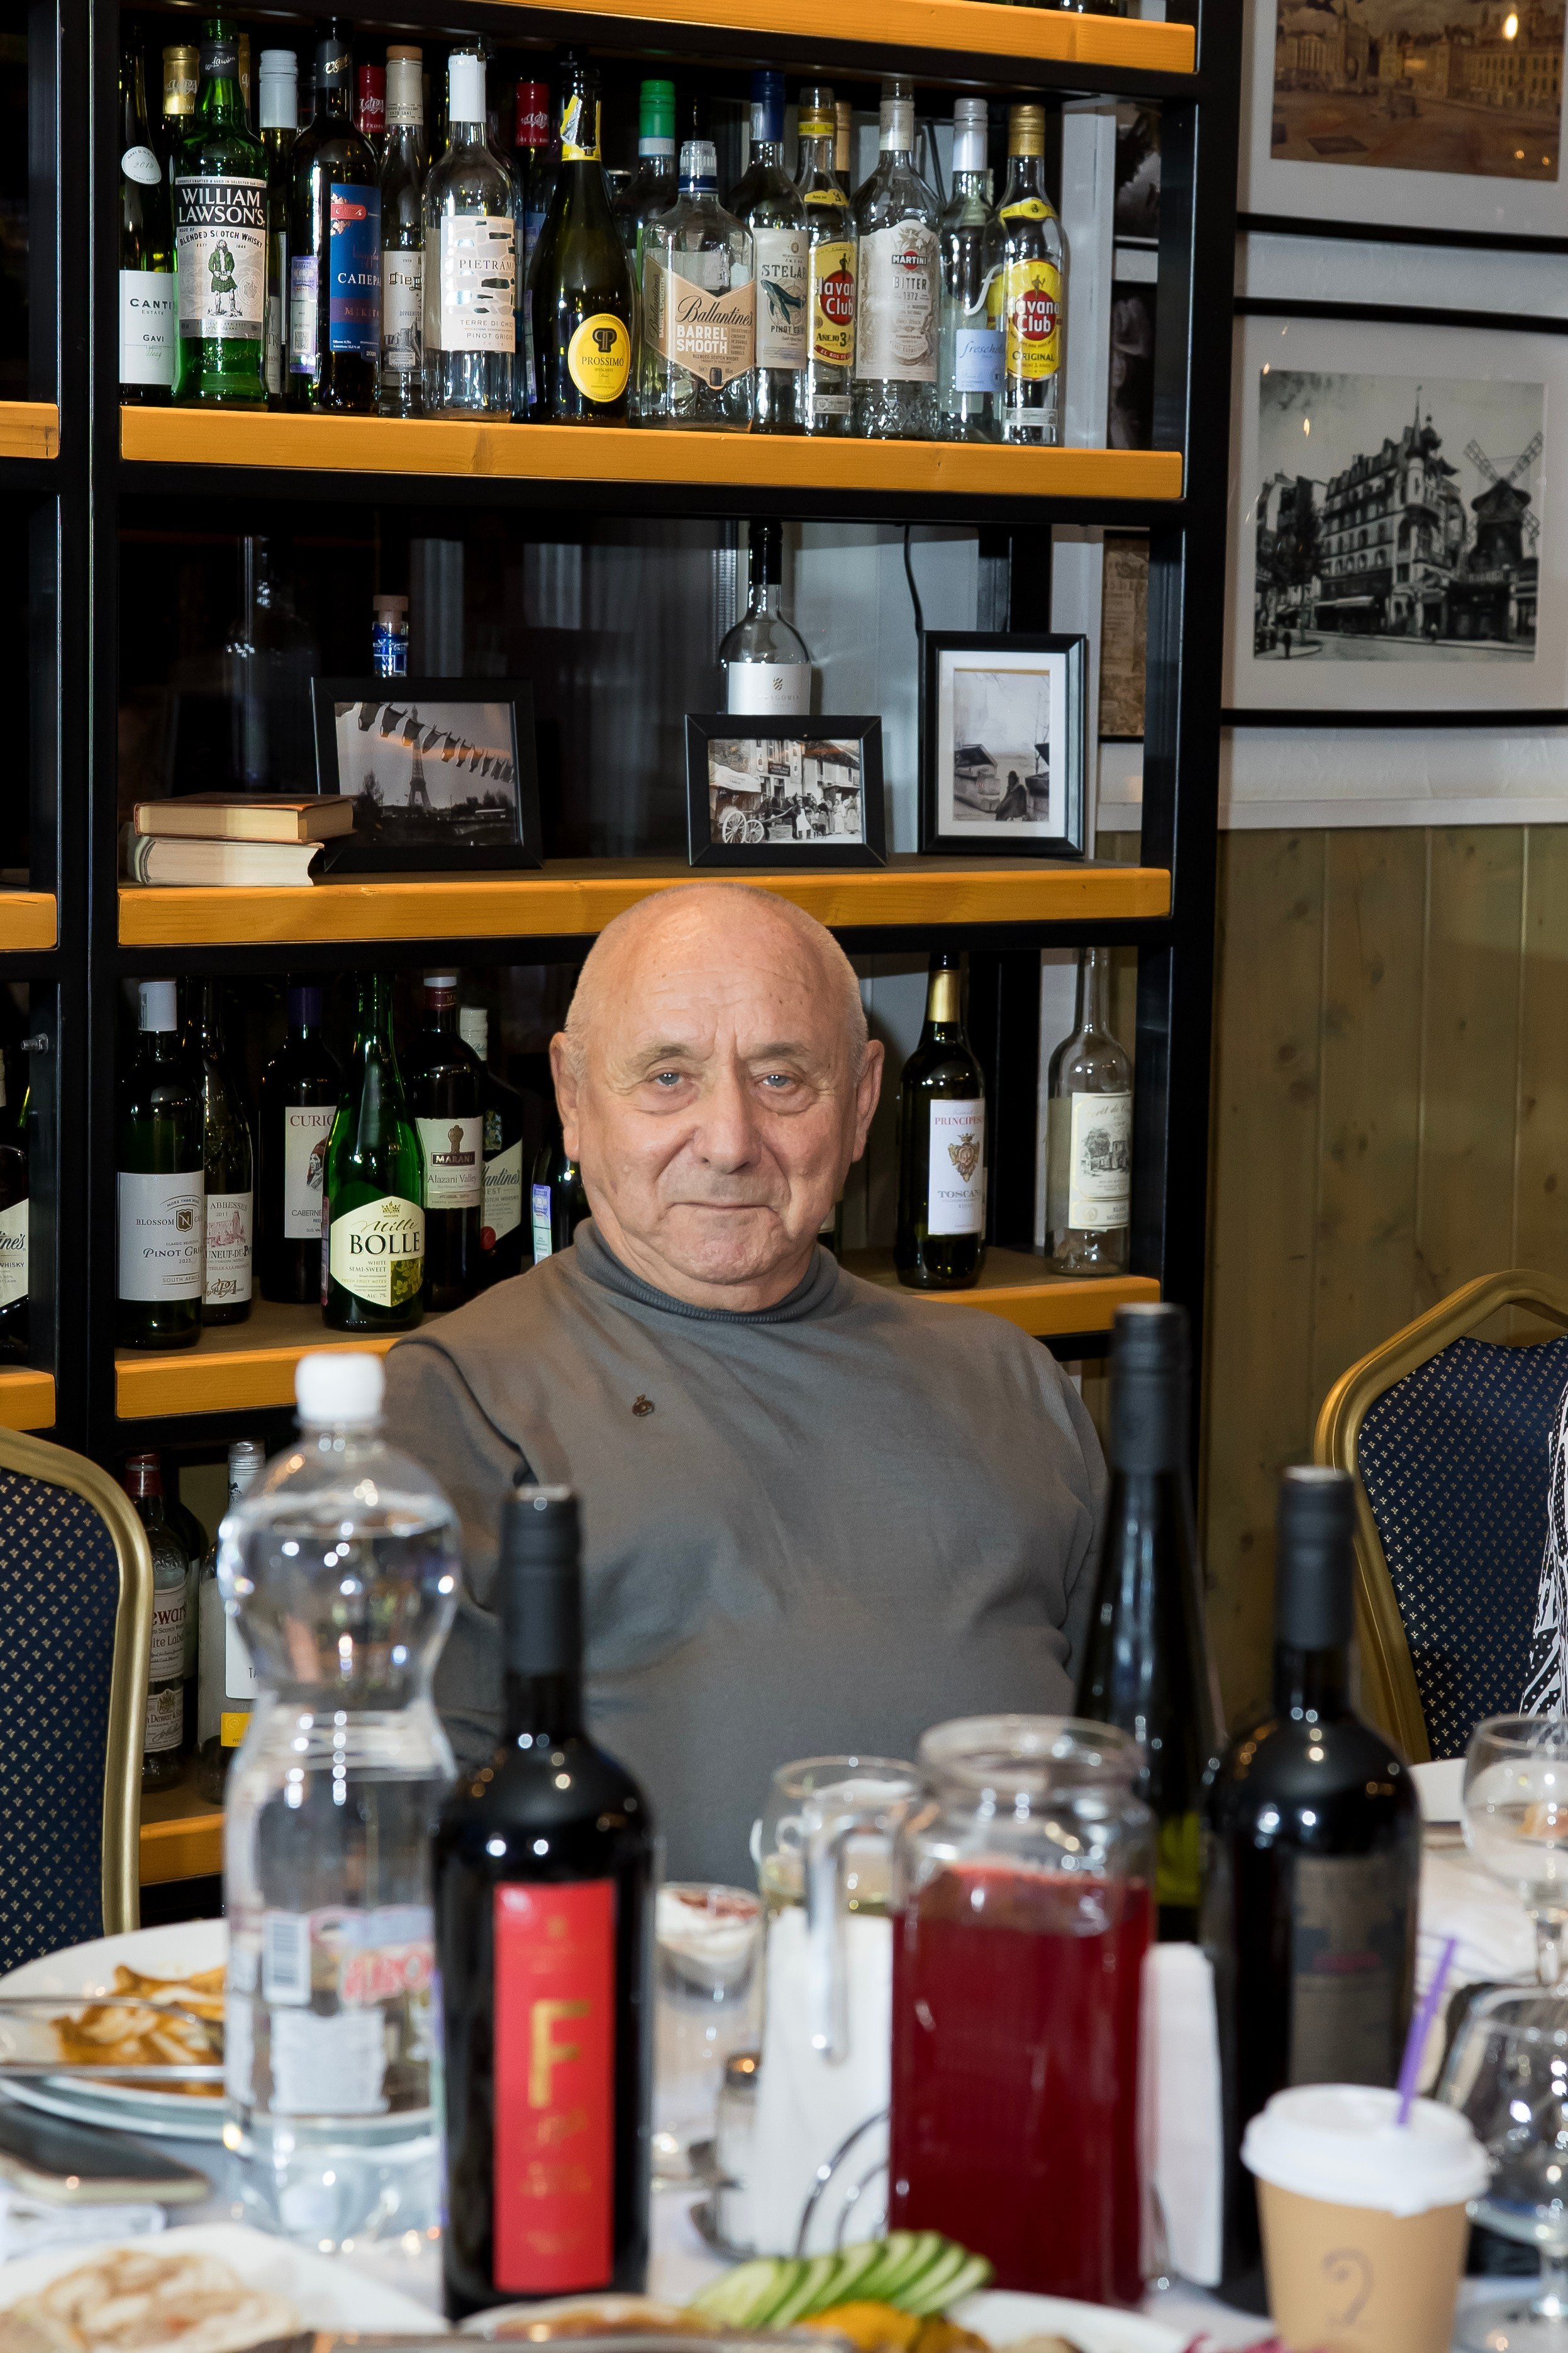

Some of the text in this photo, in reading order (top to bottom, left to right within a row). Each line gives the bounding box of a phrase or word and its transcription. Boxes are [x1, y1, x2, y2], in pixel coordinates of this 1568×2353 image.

[182, 188, 260, 208] WILLIAM
[179, 206, 264, 226] LAWSON'S
[180, 230, 263, 249] BLENDED SCOTCH WHISKY
[892, 255, 926, 265] MARTINI
[815, 277, 855, 296] Havan
[892, 276, 927, 290] BITTER
[130, 298, 172, 310] CANTI
[676, 295, 753, 327] Ballantine's
[826, 297, 854, 316] Club
[1007, 296, 1060, 315] Havana
[771, 325, 791, 333] PINOT
[1017, 314, 1052, 333] Club
[143, 334, 165, 343] GAVI
[677, 324, 728, 340] BARREL
[676, 338, 728, 354] SMOOTH
[840, 332, 847, 347] 3
[582, 356, 624, 366] PROSSIMO
[1012, 350, 1055, 361] ORIGINAL
[428, 1173, 477, 1185] Alazani Valley
[938, 1188, 979, 1199] TOSCAN
[210, 1201, 248, 1212] ABBESSES
[292, 1209, 322, 1217] CABERNE
[349, 1231, 420, 1256] BOLLE
[143, 1248, 181, 1258] PINOT
[152, 1638, 165, 1648] ite
[529, 1998, 592, 2110] F
